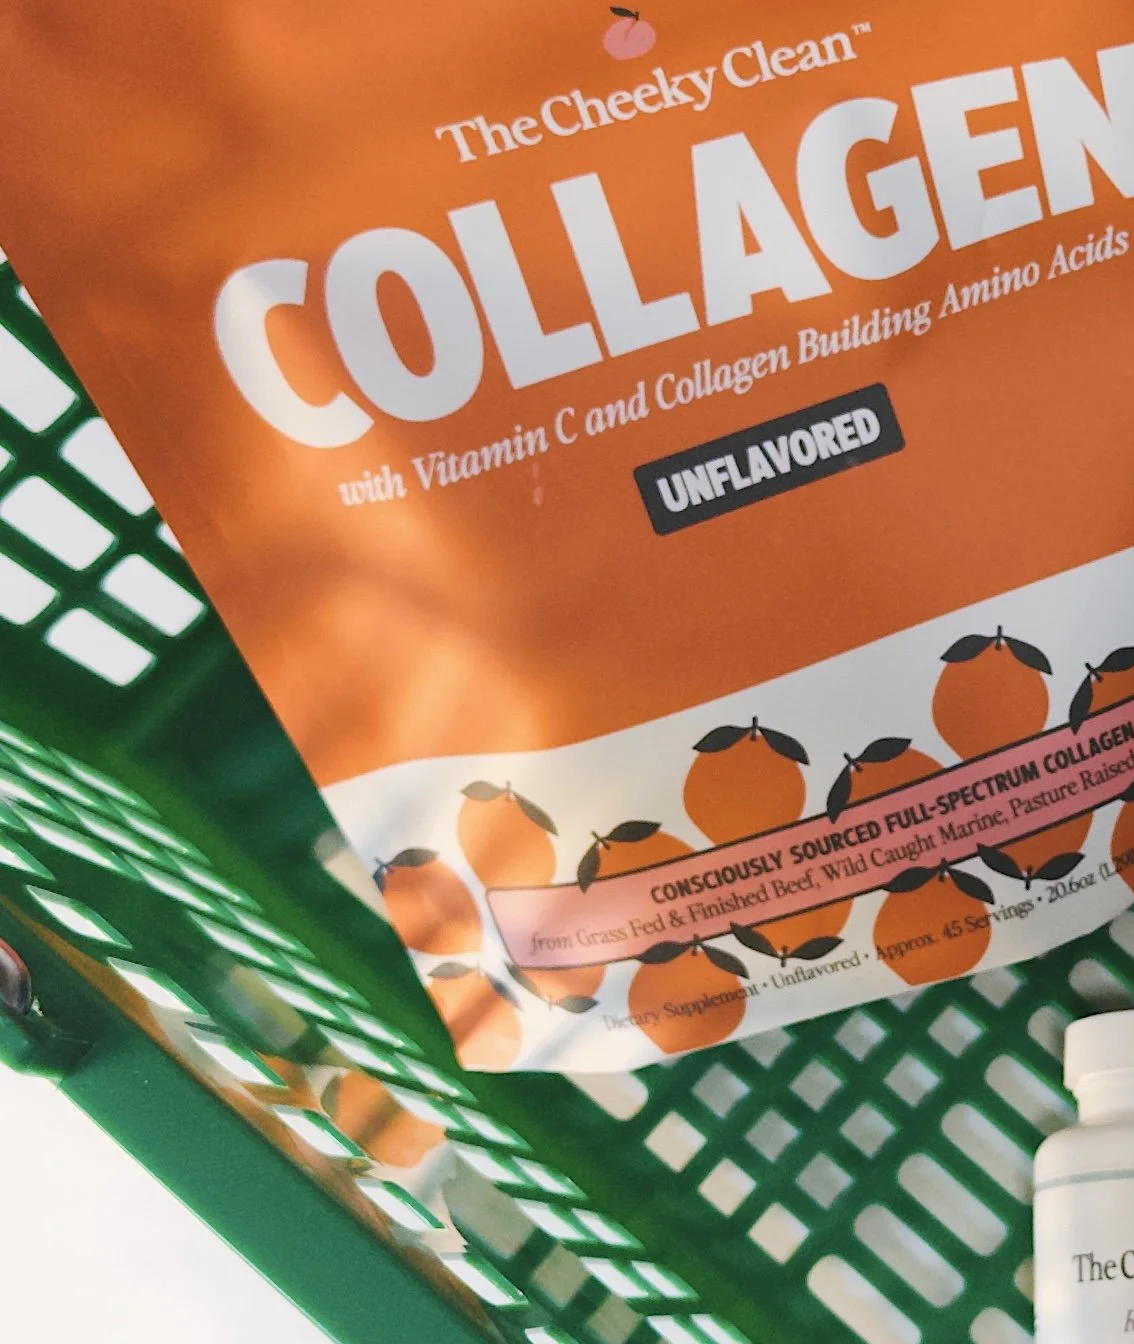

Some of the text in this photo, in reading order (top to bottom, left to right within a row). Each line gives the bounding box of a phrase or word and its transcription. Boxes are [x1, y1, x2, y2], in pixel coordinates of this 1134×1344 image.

[435, 113, 543, 163] The
[541, 65, 717, 137] Cheeky
[338, 226, 1130, 507] with Vitamin C and Collagen Building Amino Acids
[656, 406, 882, 515] UNFLAVORED
[529, 931, 573, 955] from
[576, 925, 628, 948] Grass
[629, 913, 665, 938] Fed
[668, 910, 687, 929] &
[689, 886, 770, 924] Finished
[773, 872, 822, 904] Beef,
[821, 852, 869, 885] Wild
[869, 831, 937, 870] Caught
[938, 804, 1009, 845] Marine,
[1009, 780, 1078, 818] Pasture
[650, 850, 784, 905] CONSCIOUSLY
[789, 821, 882, 866] SOURCED
[883, 763, 1041, 834] FULL-SPECTRUM
[602, 1007, 661, 1032] Dietary
[663, 982, 760, 1020] Supplement
[769, 956, 862, 991] Unflavored
[875, 933, 940, 964] Approx.
[942, 920, 962, 940] 45
[964, 897, 1036, 933] Servings
[1072, 1252, 1117, 1283] The
